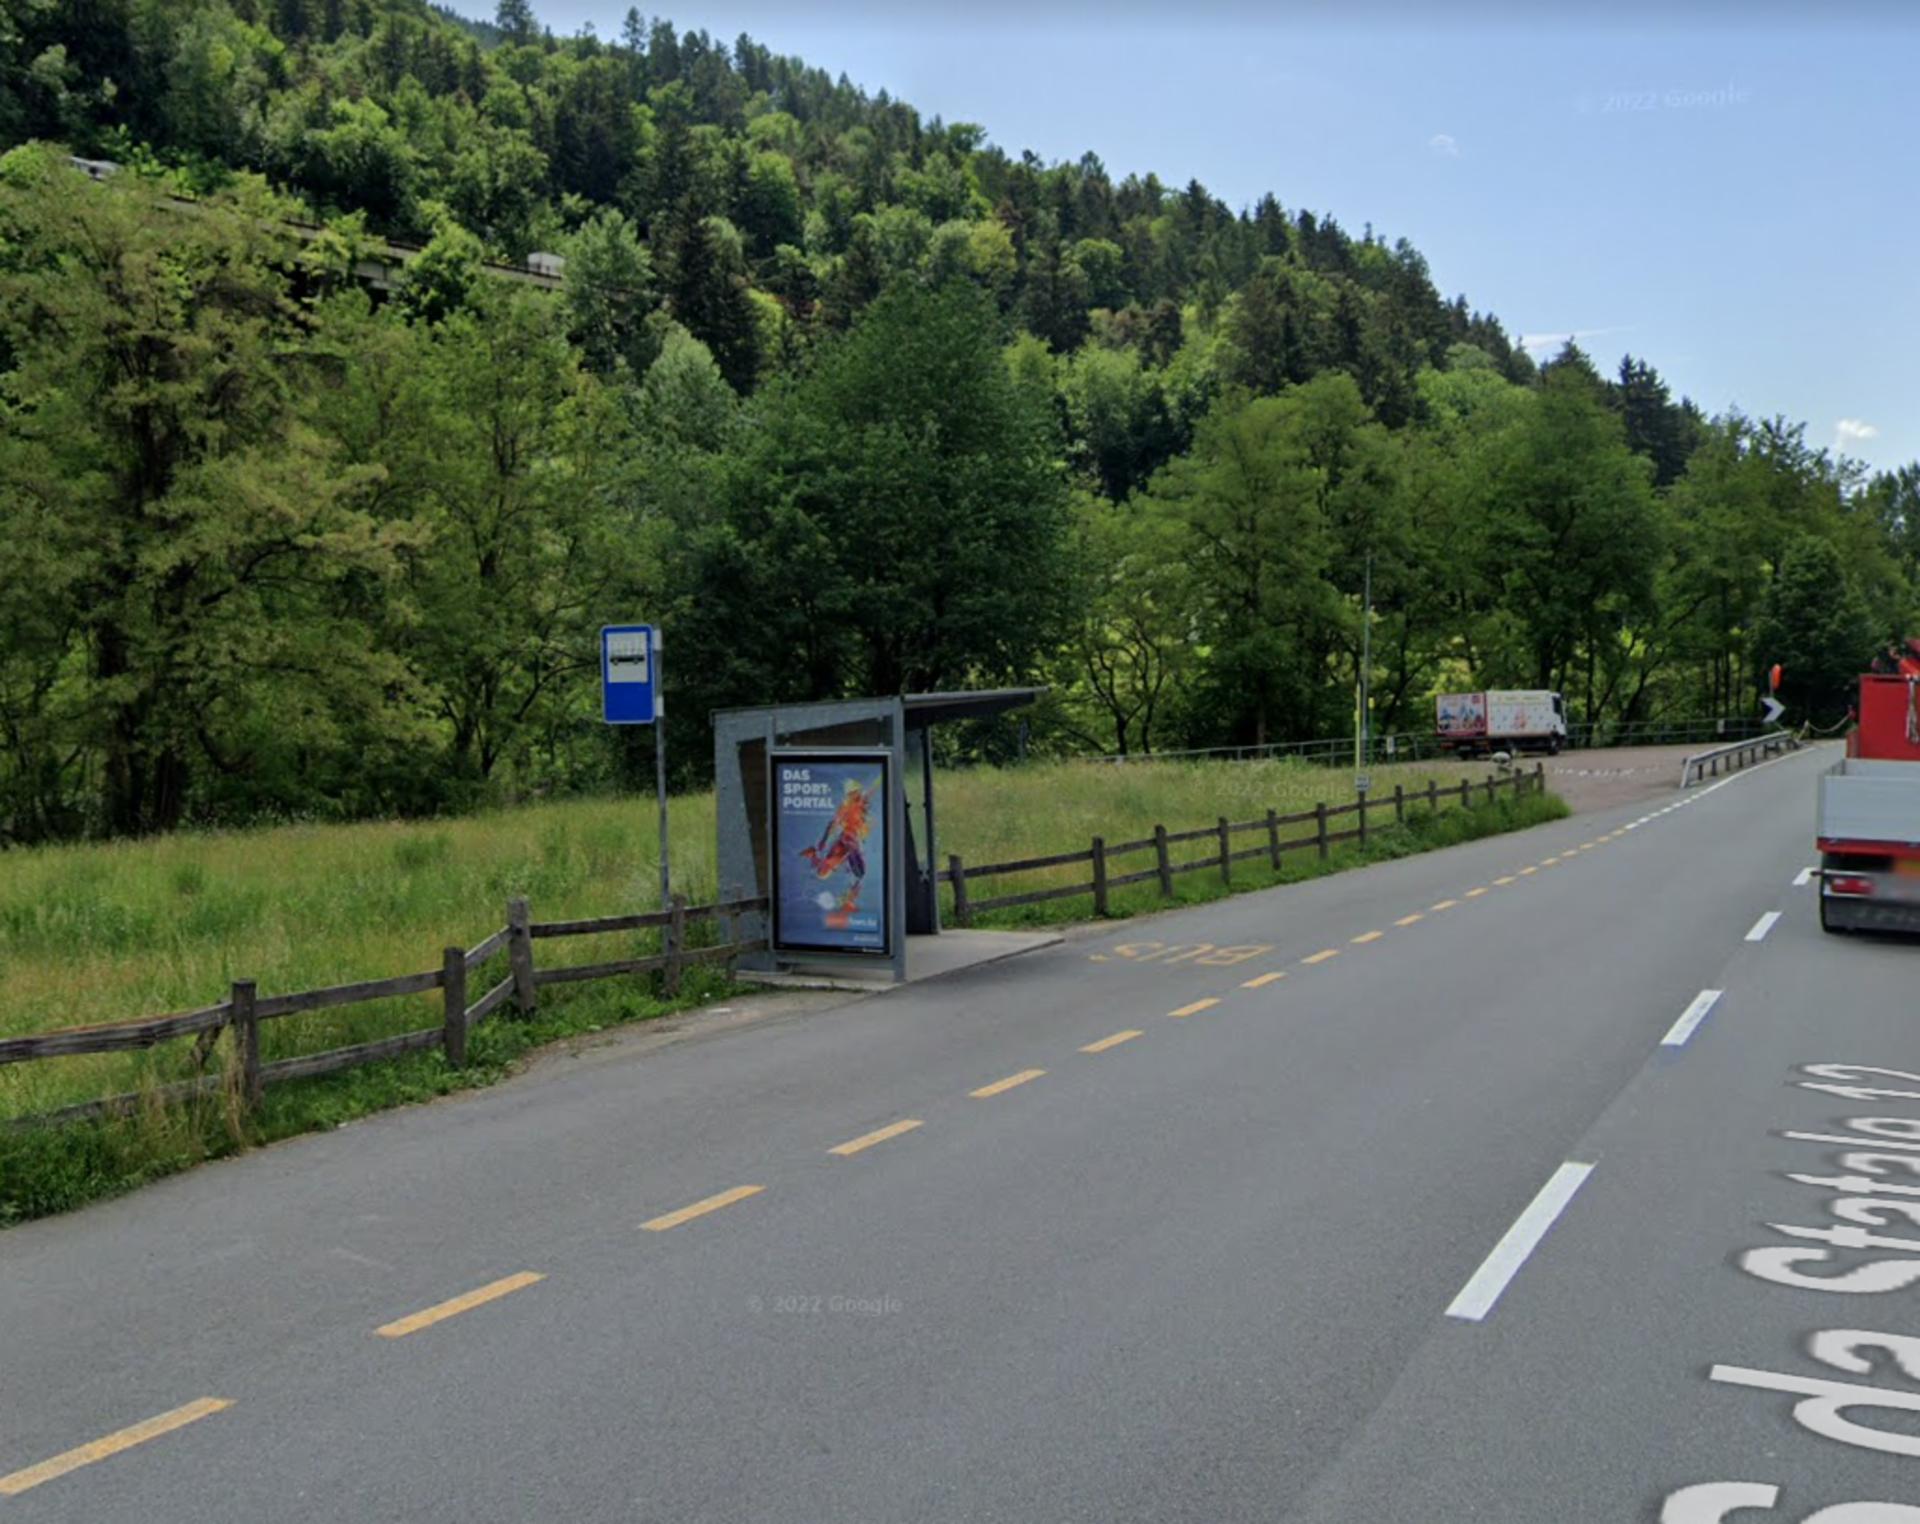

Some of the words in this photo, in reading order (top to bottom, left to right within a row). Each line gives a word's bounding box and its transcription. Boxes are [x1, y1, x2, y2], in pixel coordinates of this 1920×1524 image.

[783, 769, 810, 781] DAS
[783, 783, 832, 795] SPORT-
[783, 797, 835, 809] PORTAL
